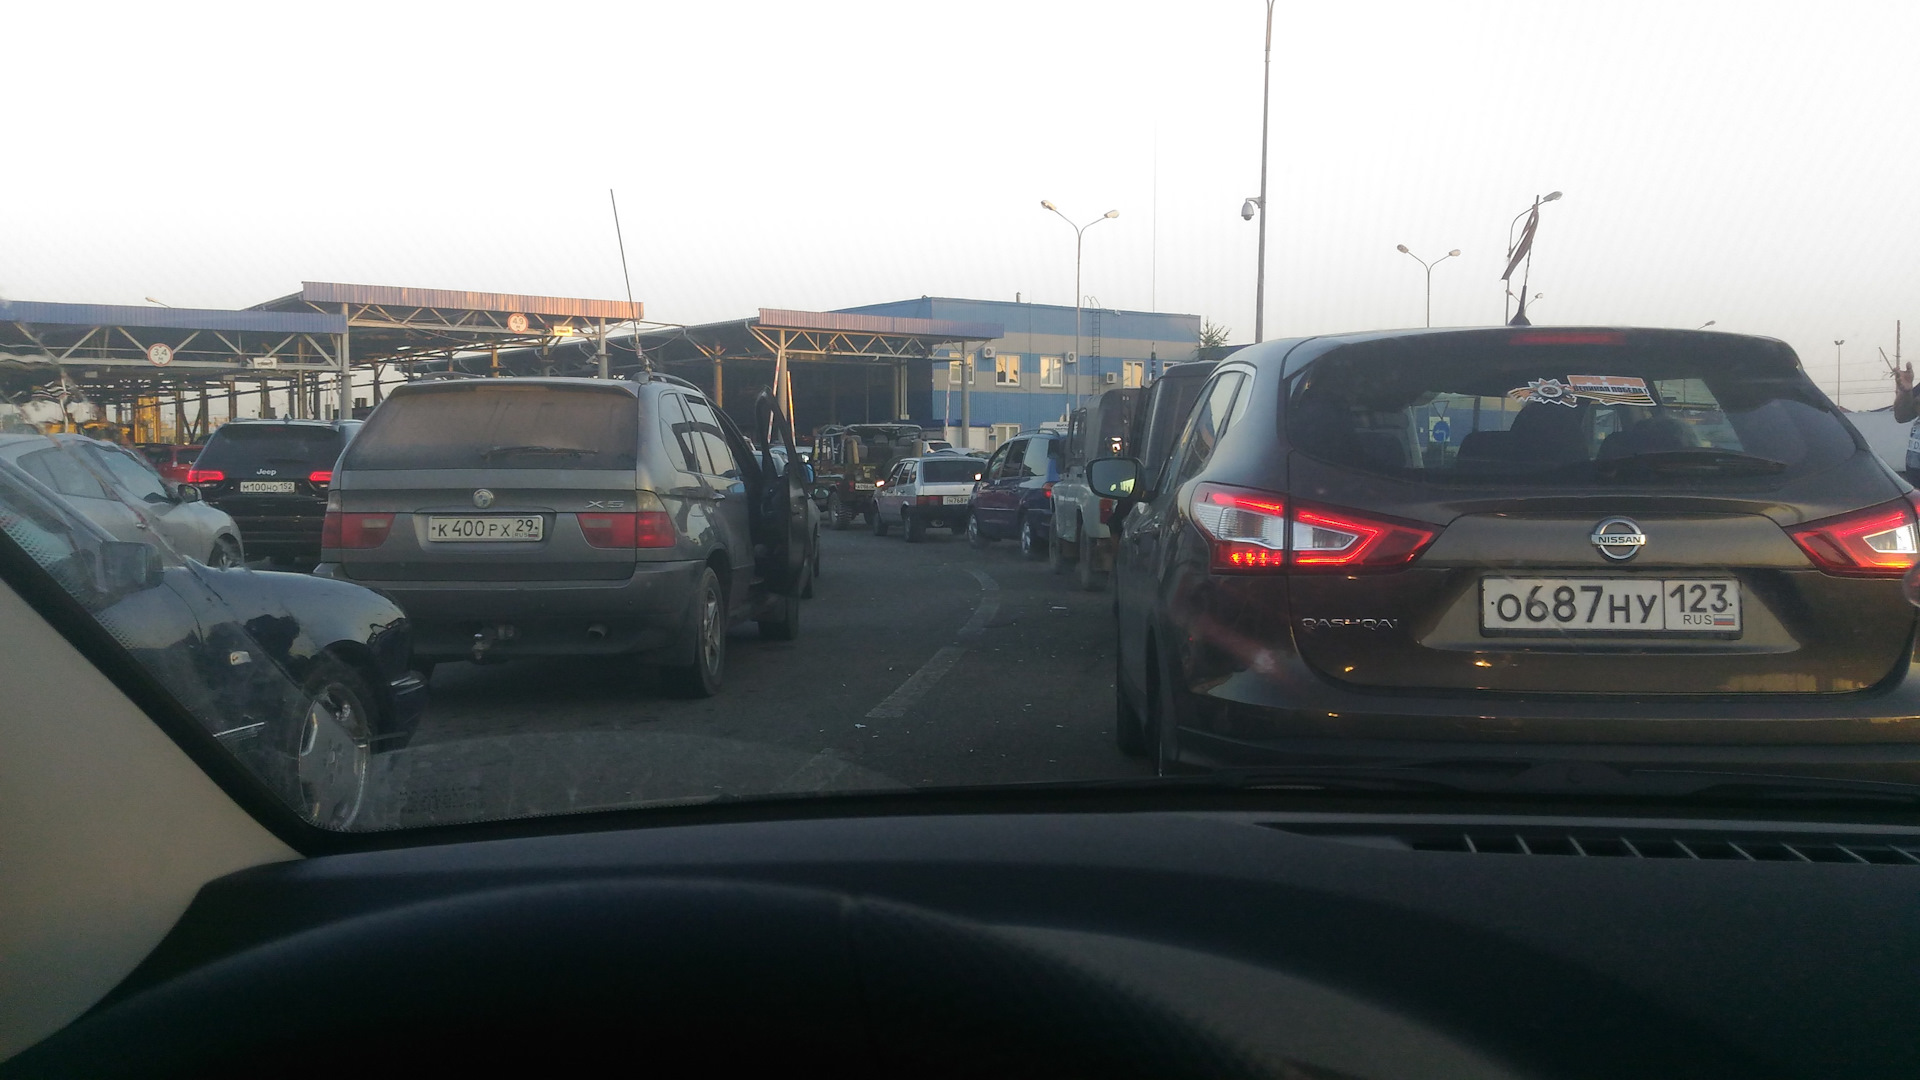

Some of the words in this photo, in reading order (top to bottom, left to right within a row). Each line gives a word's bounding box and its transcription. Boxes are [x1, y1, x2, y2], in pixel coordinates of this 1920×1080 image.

[256, 468, 277, 476] Jeep
[585, 500, 625, 508] X5
[1598, 535, 1642, 544] NISSAN
[1683, 614, 1713, 625] RUS
